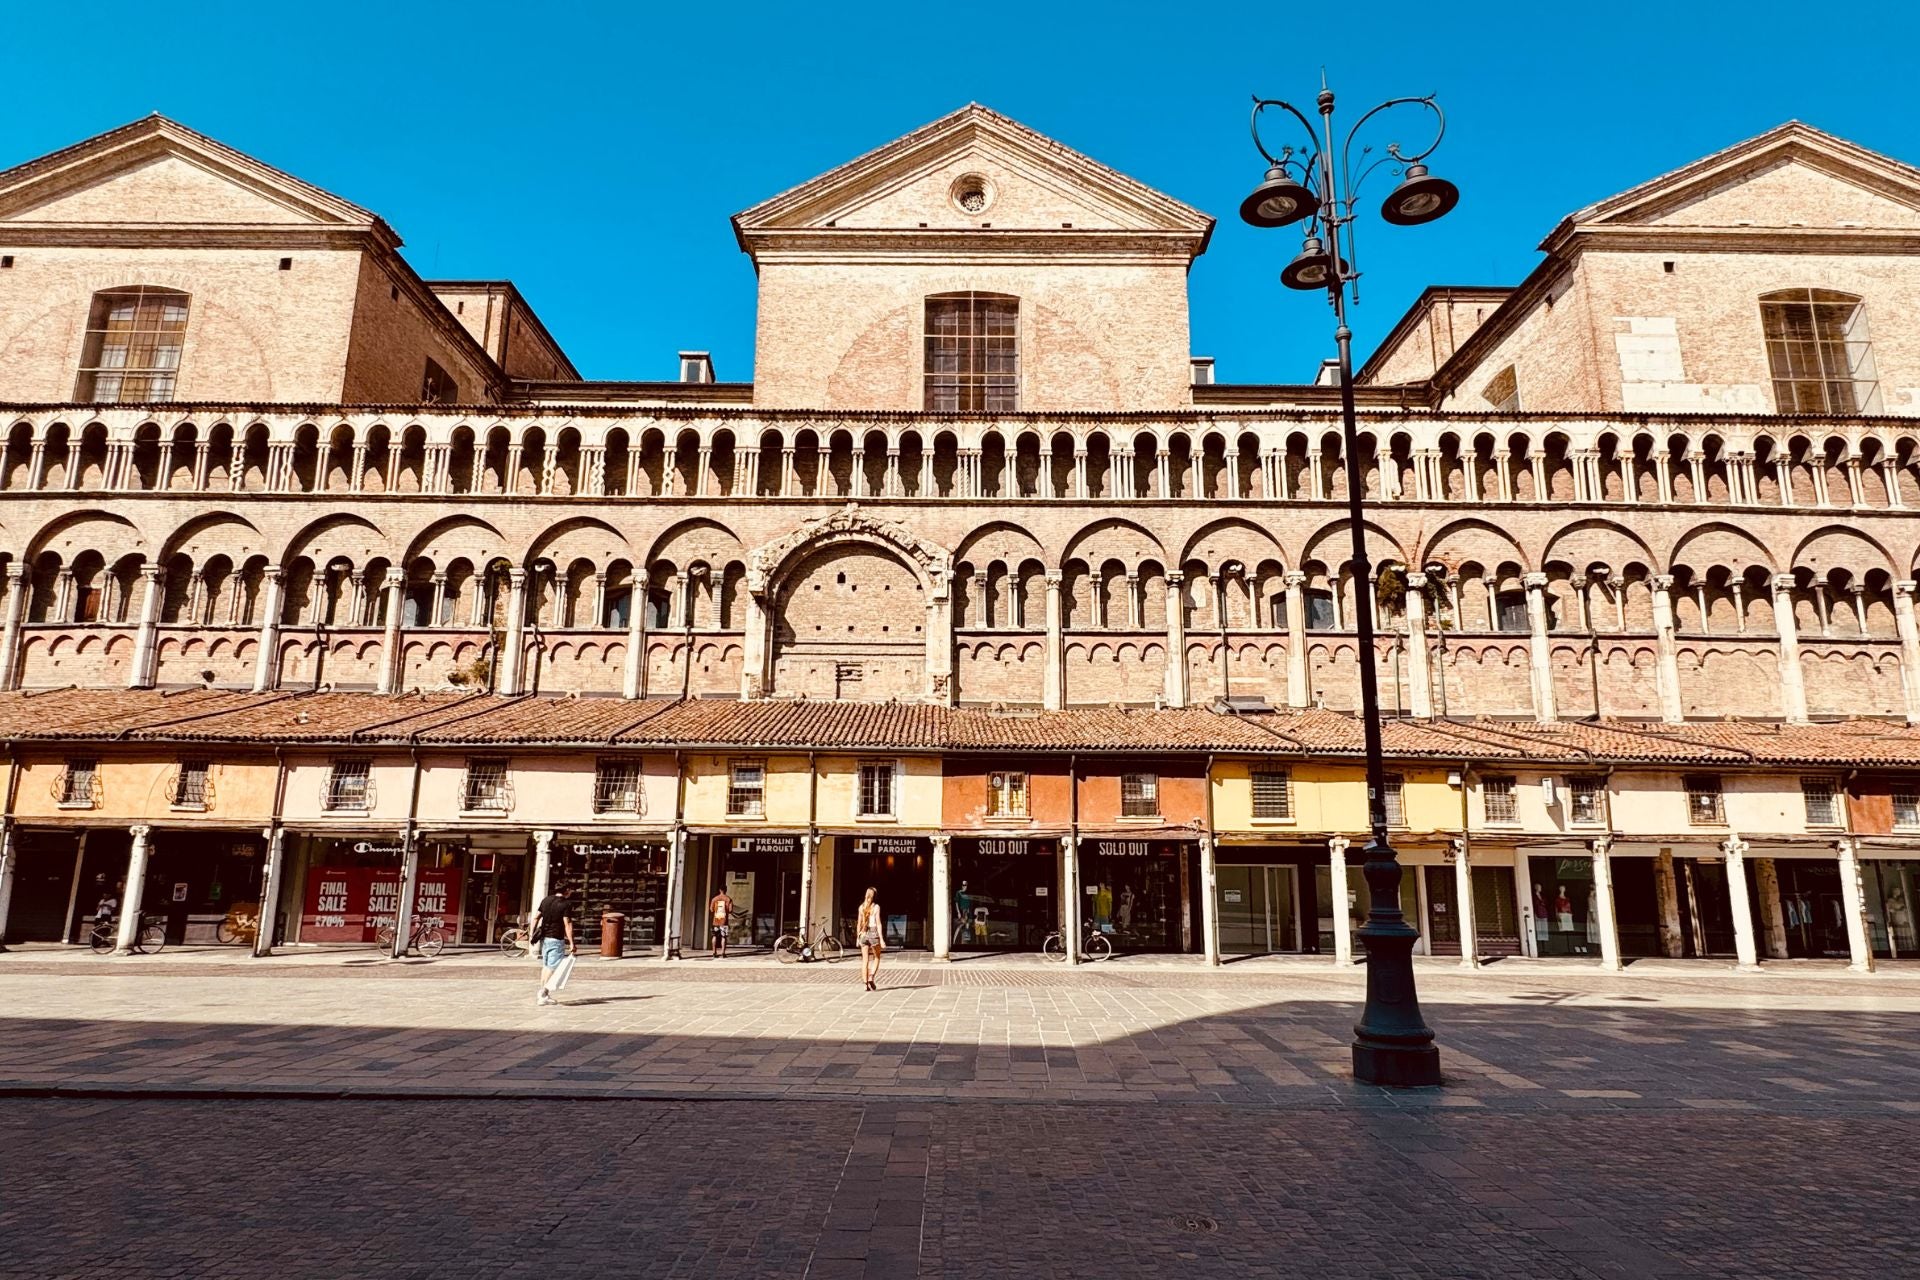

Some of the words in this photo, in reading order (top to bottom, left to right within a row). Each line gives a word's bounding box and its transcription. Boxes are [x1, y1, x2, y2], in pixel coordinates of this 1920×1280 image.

[573, 844, 640, 859] Champion
[979, 840, 1005, 855] SOLD
[1008, 840, 1029, 855] OUT
[1099, 842, 1126, 856] SOLD
[1128, 842, 1149, 856] OUT
[319, 882, 348, 895] FINAL
[370, 882, 398, 895] FINAL
[419, 882, 447, 896] FINAL
[317, 897, 346, 912] SALE
[368, 897, 397, 912] SALE
[417, 898, 446, 912] SALE
